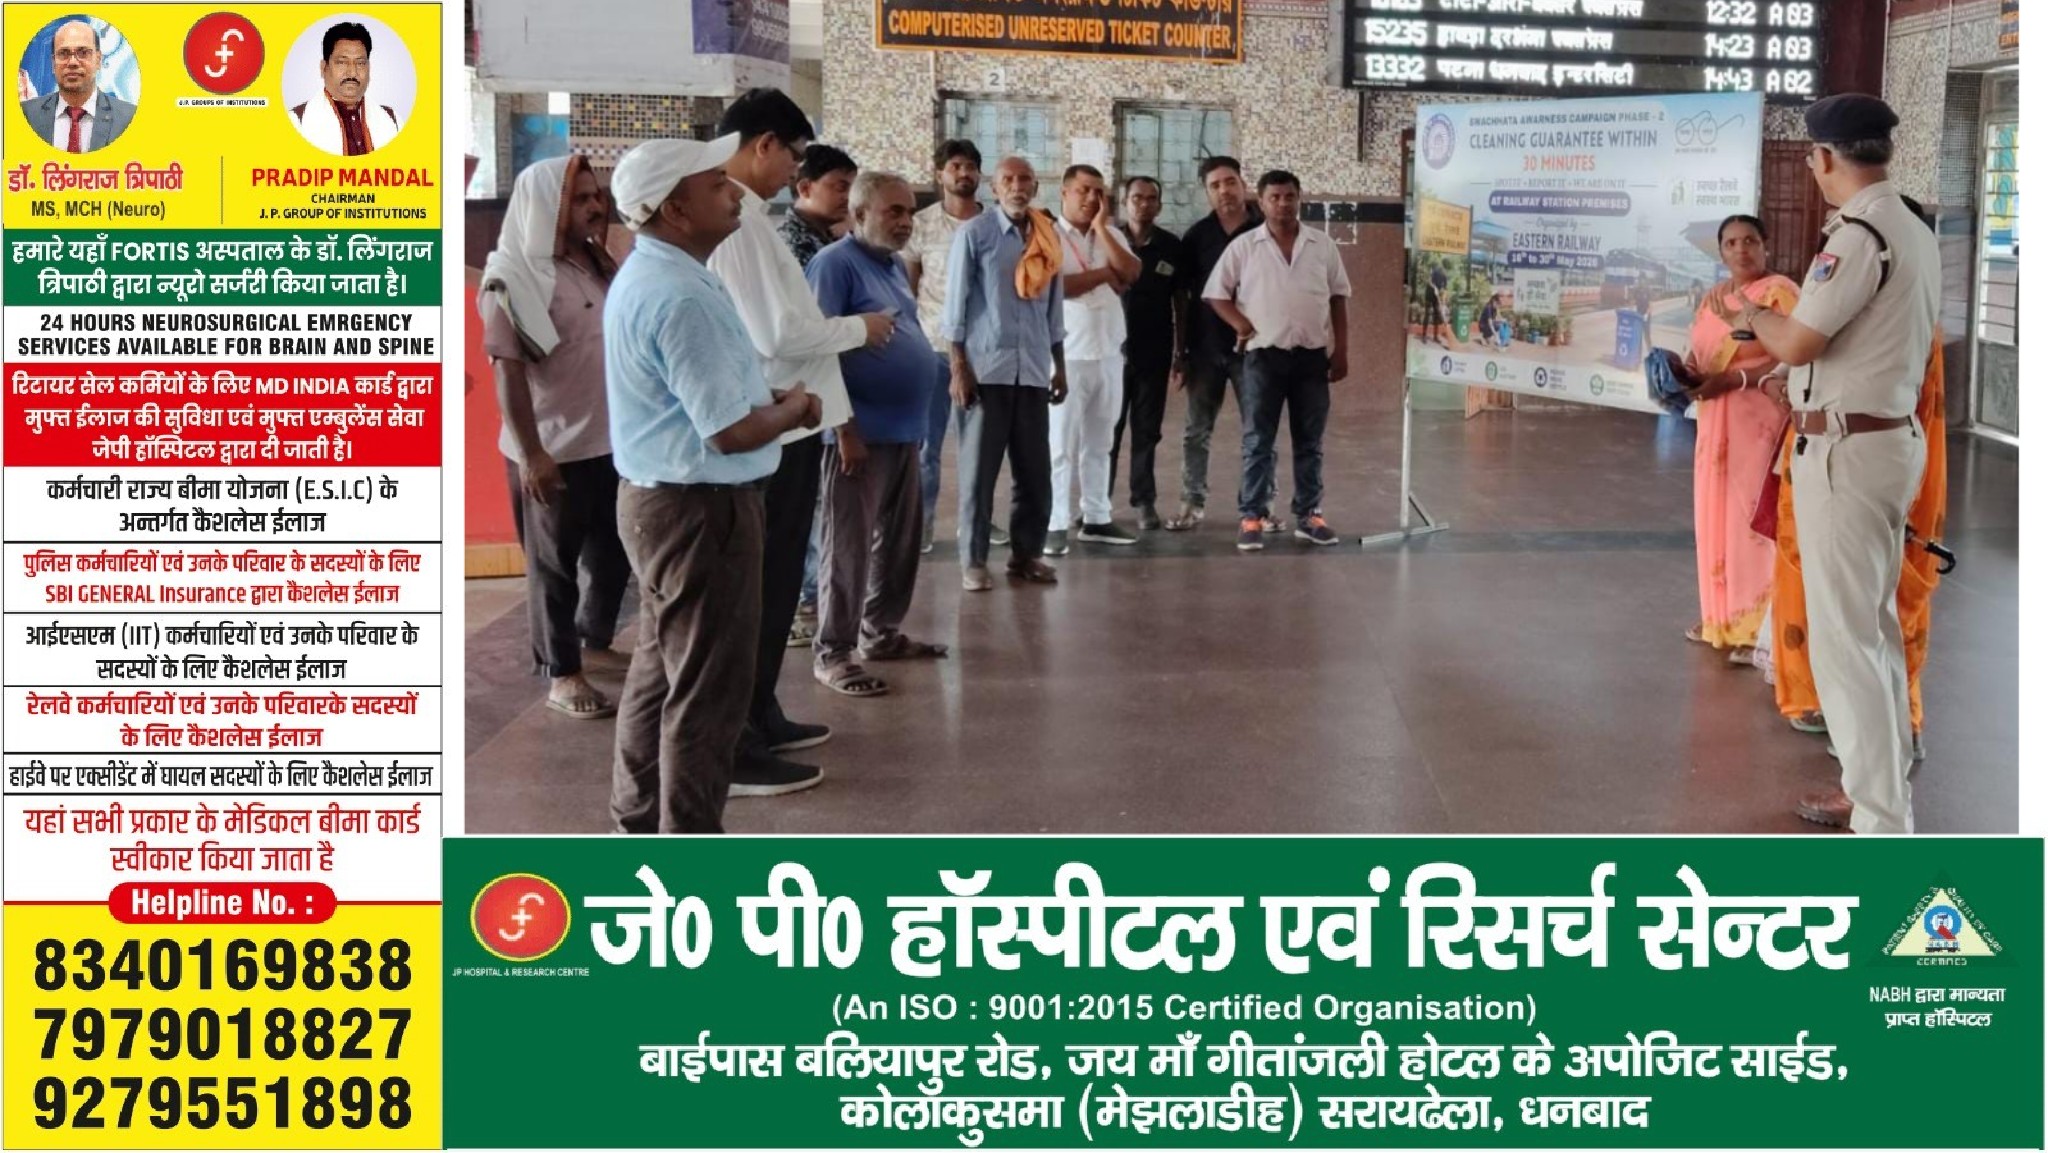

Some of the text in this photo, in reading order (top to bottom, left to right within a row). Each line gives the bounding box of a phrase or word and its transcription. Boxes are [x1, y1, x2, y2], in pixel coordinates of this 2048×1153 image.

[1706, 0, 1757, 25] 12:32
[1769, 2, 1783, 26] A
[1787, 2, 1814, 27] 03
[889, 10, 1005, 39] COMPUTERISED
[1008, 15, 1104, 44] UNRESERVED
[1108, 19, 1161, 47] TICKET
[1365, 18, 1428, 46] 15235
[1704, 33, 1755, 58] 14:23
[1767, 36, 1781, 59] A
[1785, 36, 1812, 60] 03
[989, 74, 999, 86] 2
[1365, 53, 1427, 81] 13332
[1704, 67, 1753, 91] 14:43
[1766, 68, 1780, 93] A
[1784, 68, 1812, 94] 02
[1569, 112, 1616, 124] CAMPAIGN
[1618, 112, 1649, 122] PHASE
[1658, 113, 1664, 121] 2
[1469, 130, 1657, 149] CLEANING GUARANTEE WITHIN
[1523, 155, 1596, 171] 30 MINUTES
[1491, 196, 1501, 206] AT
[1503, 196, 1541, 207] RAILWAY
[1542, 197, 1579, 208] STATION
[1512, 233, 1602, 251] EASTERN RAILWAY
[1556, 255, 1575, 268] May
